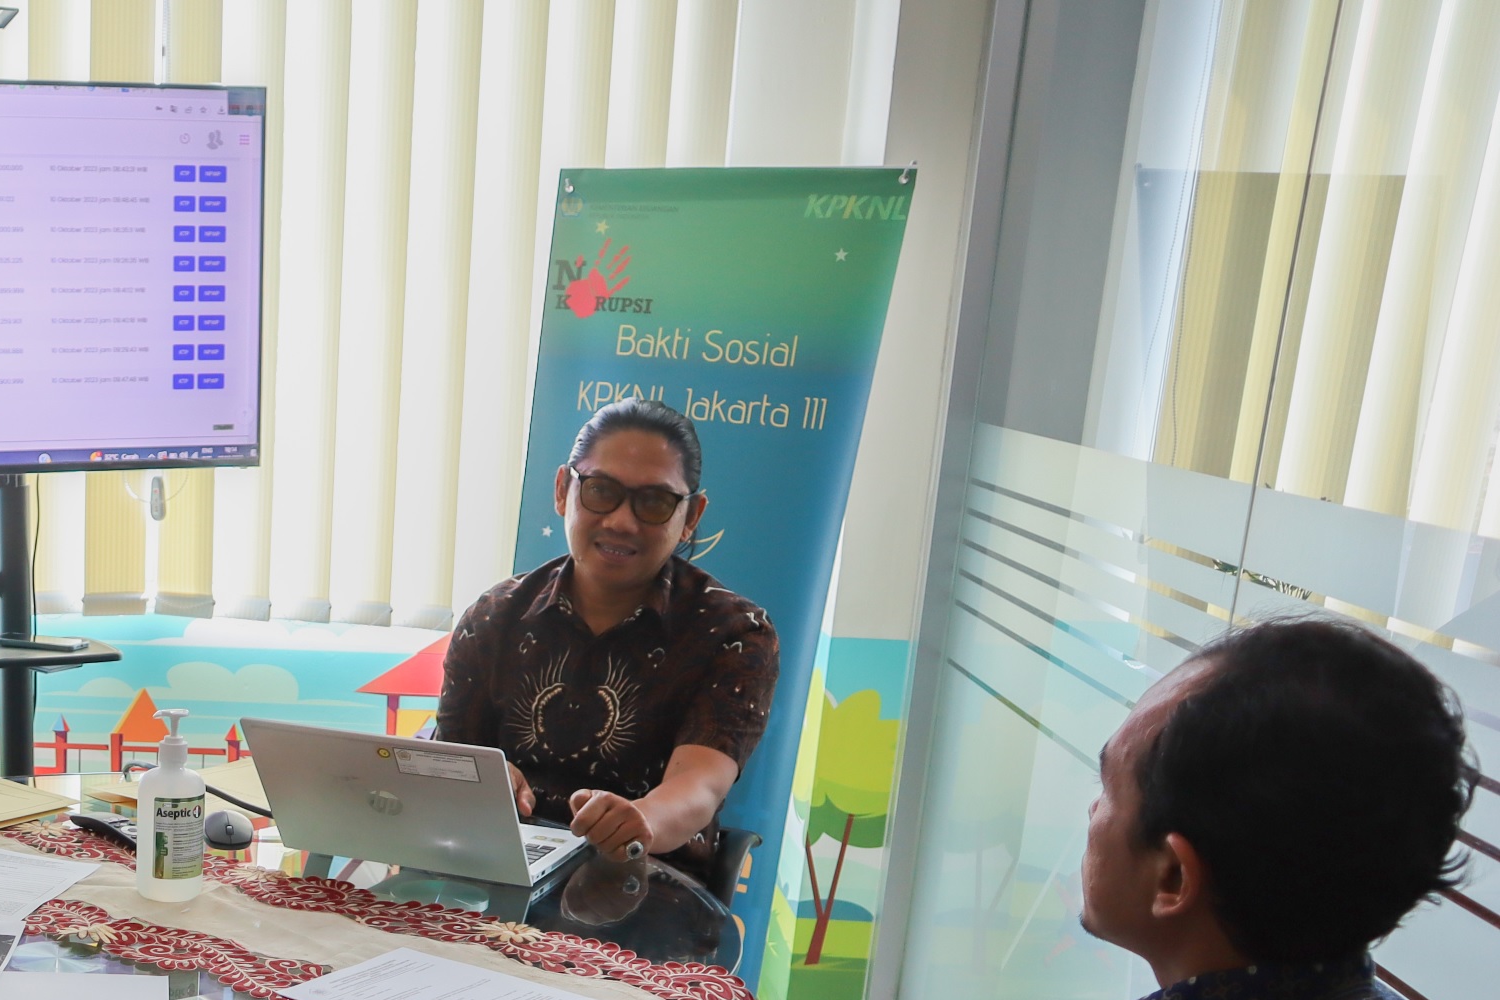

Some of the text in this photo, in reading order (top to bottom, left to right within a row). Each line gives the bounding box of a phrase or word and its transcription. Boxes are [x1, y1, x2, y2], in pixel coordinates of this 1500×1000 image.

[804, 193, 908, 220] KPKNL
[616, 324, 798, 368] Bakti Sosial
[685, 387, 789, 429] Jakarta
[156, 807, 191, 820] Aseptic
